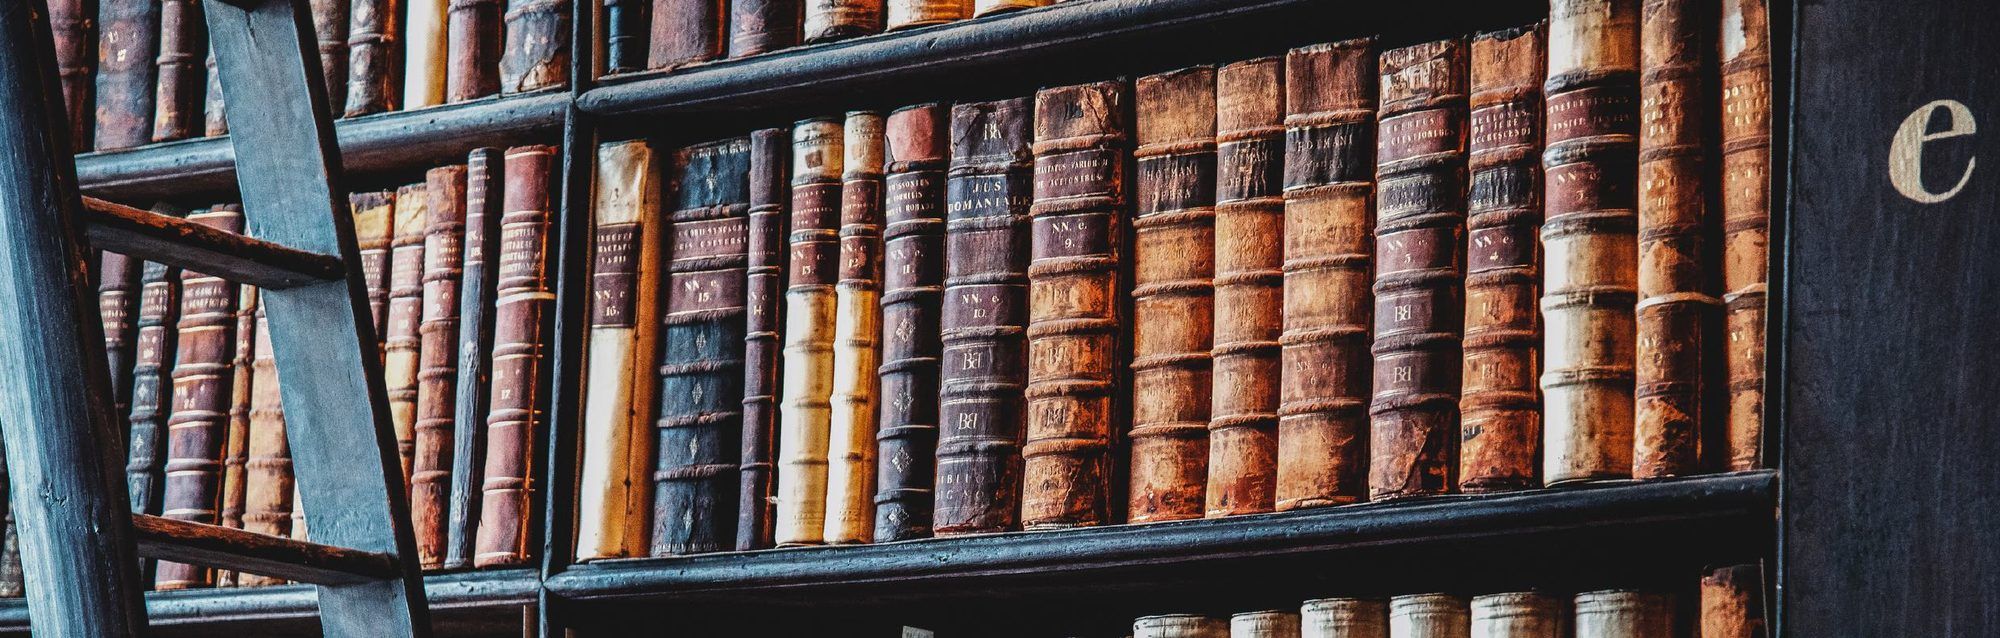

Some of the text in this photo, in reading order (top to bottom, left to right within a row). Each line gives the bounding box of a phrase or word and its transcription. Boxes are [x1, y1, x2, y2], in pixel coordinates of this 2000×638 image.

[1889, 99, 1977, 204] e
[972, 181, 1002, 193] JUS
[1052, 222, 1072, 234] NN.
[1064, 238, 1075, 248] 9.
[962, 293, 983, 305] NN.
[973, 308, 987, 318] 10.
